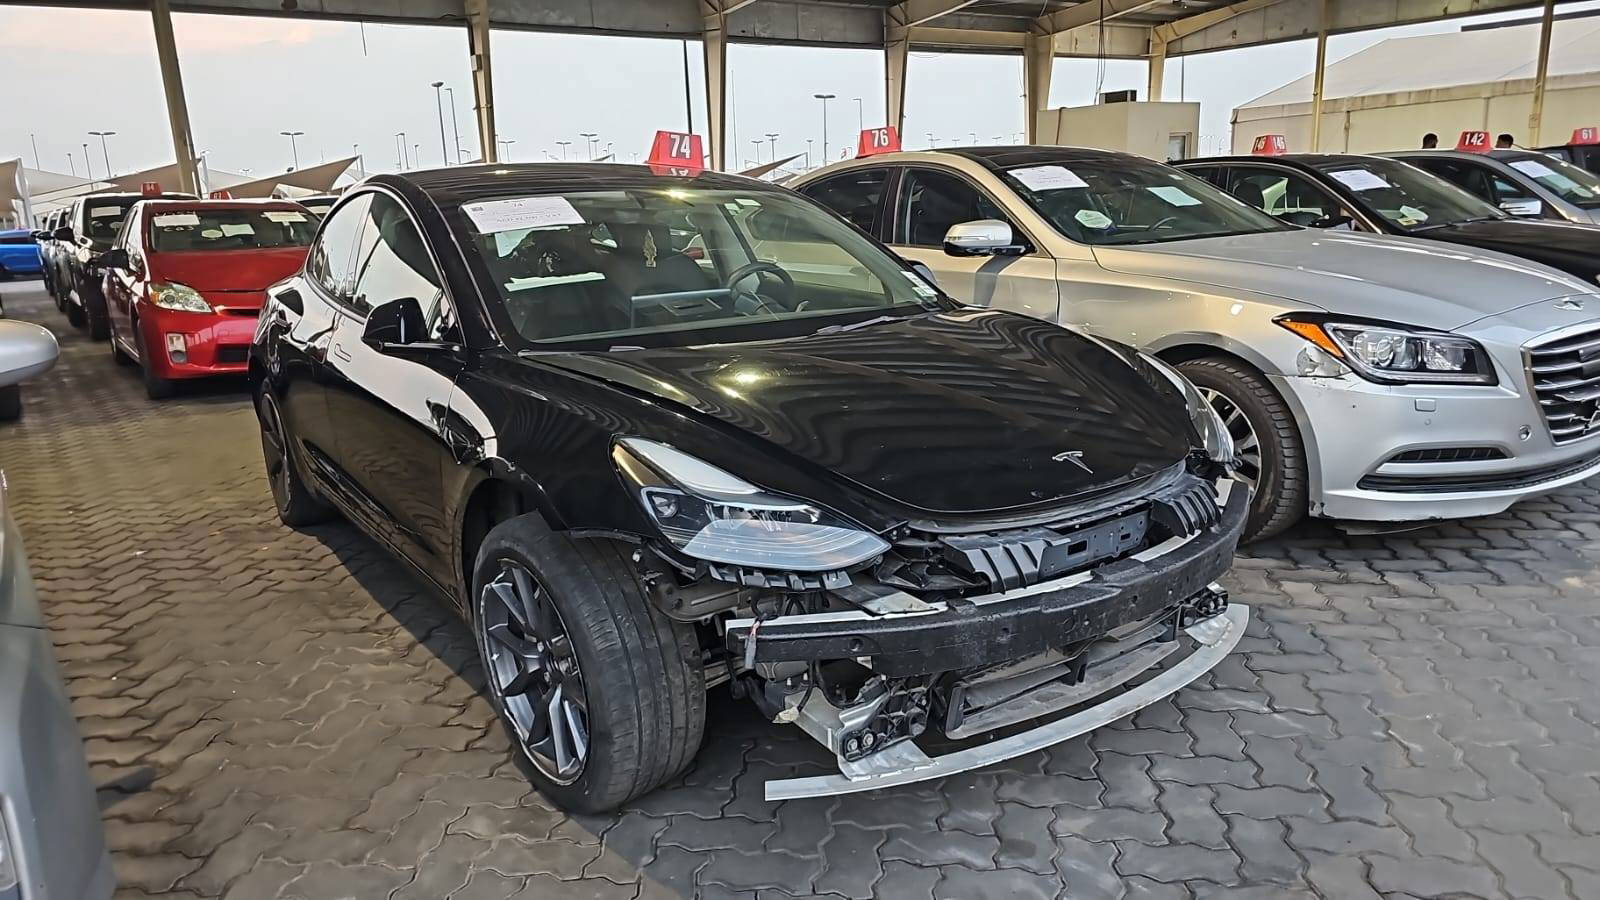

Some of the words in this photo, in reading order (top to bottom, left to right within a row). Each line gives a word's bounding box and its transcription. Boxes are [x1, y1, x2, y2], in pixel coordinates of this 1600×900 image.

[670, 134, 691, 159] 74
[871, 129, 889, 148] 76
[1464, 132, 1485, 146] 142
